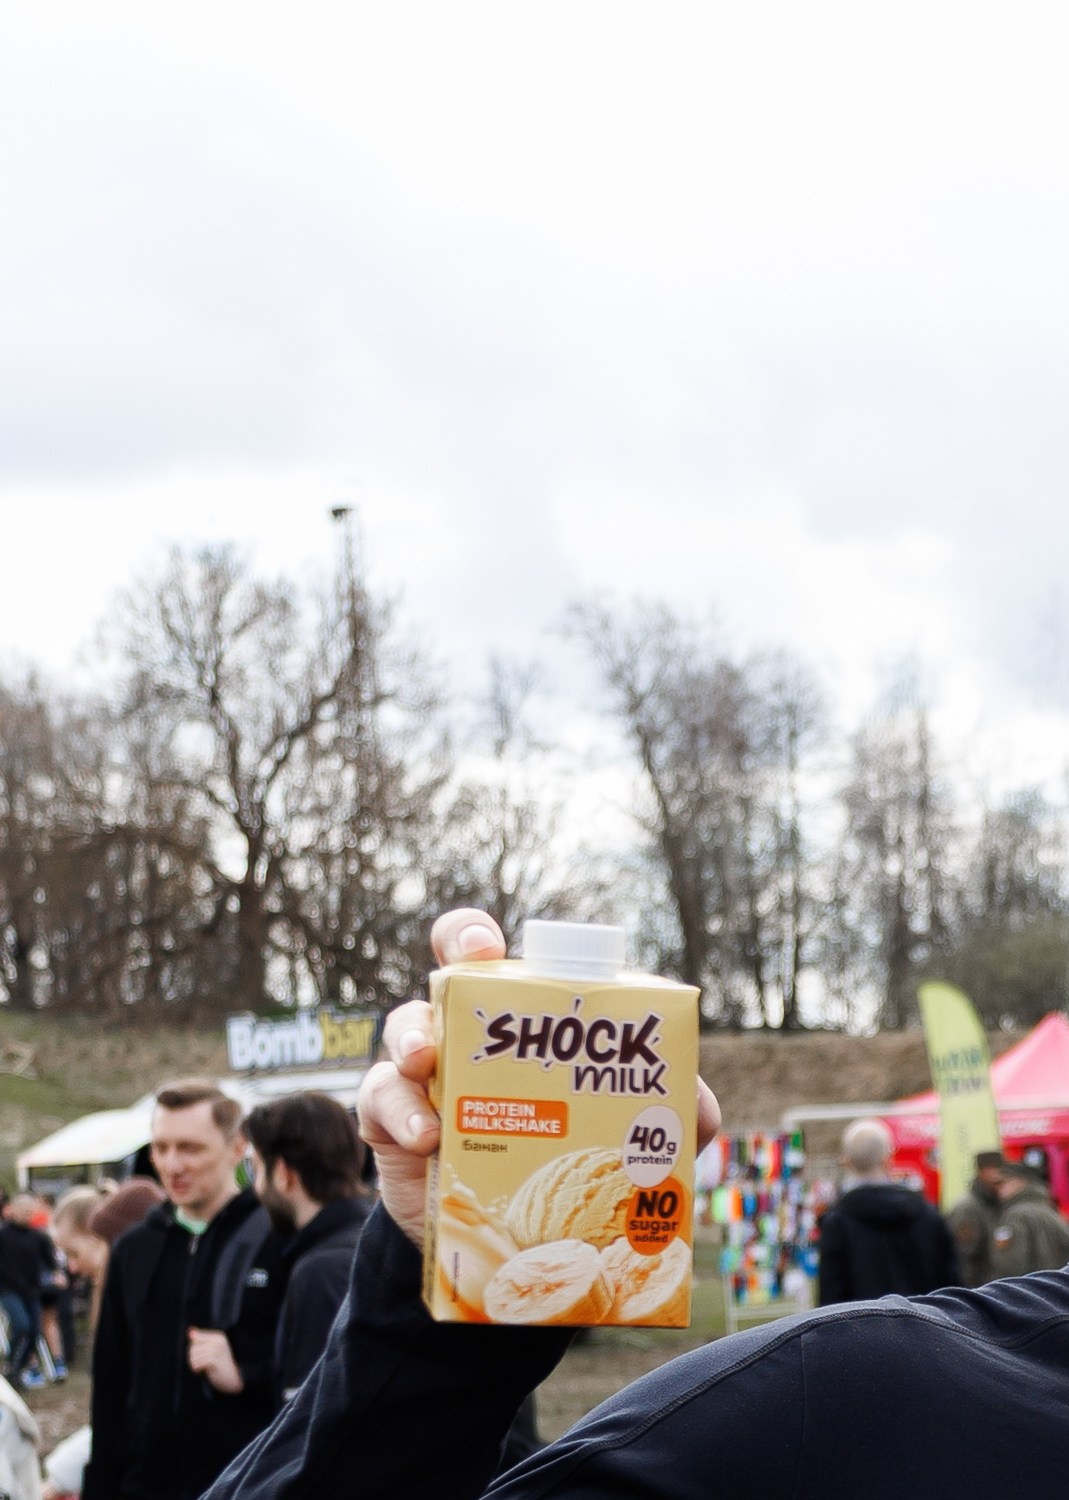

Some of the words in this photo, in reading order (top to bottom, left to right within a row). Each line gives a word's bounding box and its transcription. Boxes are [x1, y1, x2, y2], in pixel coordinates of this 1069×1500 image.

[227, 1008, 376, 1070] Bombbar
[484, 1013, 661, 1066] SHOCK
[463, 1101, 536, 1117] PROTEIN
[463, 1116, 561, 1134] MILKSHAKE
[627, 1155, 673, 1166] protein
[636, 1190, 678, 1219] NO
[629, 1220, 679, 1235] sugar
